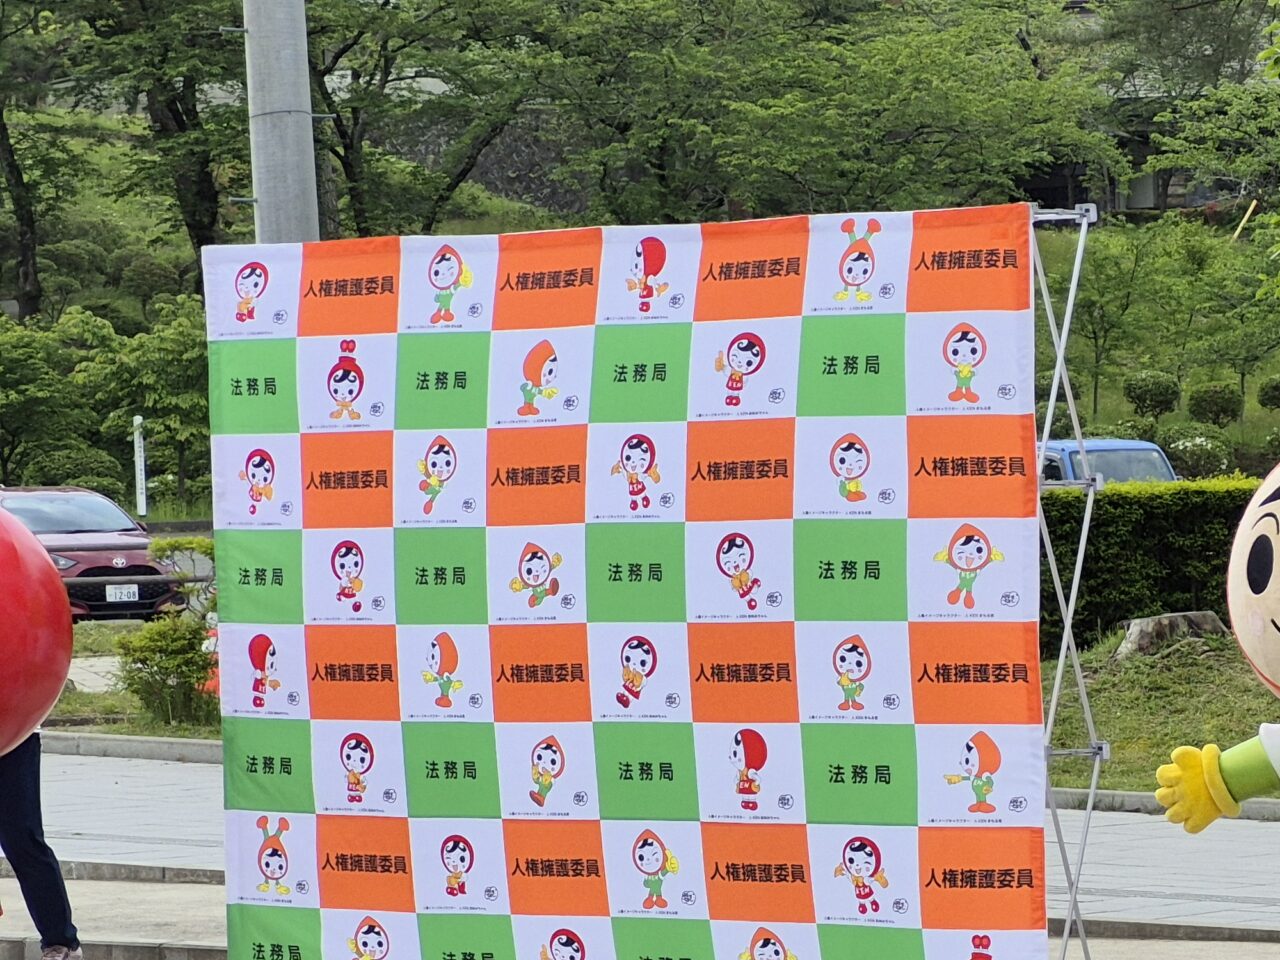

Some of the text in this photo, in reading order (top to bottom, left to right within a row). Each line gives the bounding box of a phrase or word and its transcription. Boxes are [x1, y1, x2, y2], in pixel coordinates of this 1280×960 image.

[915, 249, 1018, 270] 人権擁護委員
[501, 268, 593, 290] 人権擁護委員
[703, 258, 800, 281] 人権擁護委員
[304, 276, 393, 297] 人権擁護委員
[614, 363, 666, 382] 法務局
[823, 356, 879, 375] 法務局
[231, 378, 276, 395] 法務局
[417, 372, 466, 390] 法務局
[491, 465, 580, 486] 人権擁護委員
[692, 459, 788, 481] 人権擁護委員
[915, 456, 1026, 476] 人権擁護委員
[307, 470, 388, 489] 人権擁護委員
[239, 568, 283, 586] 法務局
[416, 567, 465, 585] 法務局
[609, 563, 662, 582] 法務局
[819, 561, 880, 579] 法務局
[312, 664, 393, 682] 人権擁護委員
[497, 664, 584, 683] 人権擁護委員
[696, 663, 791, 682] 人権擁護委員
[918, 663, 1029, 683] 人権擁護委員
[246, 756, 291, 775] 法務局
[426, 761, 476, 779] 法務局
[619, 762, 673, 781] 法務局
[829, 764, 890, 784] 法務局
[322, 853, 407, 874] 人権擁護委員
[512, 858, 600, 877] 人権擁護委員
[711, 862, 806, 883] 人権擁護委員
[925, 869, 1034, 888] 人権擁護委員
